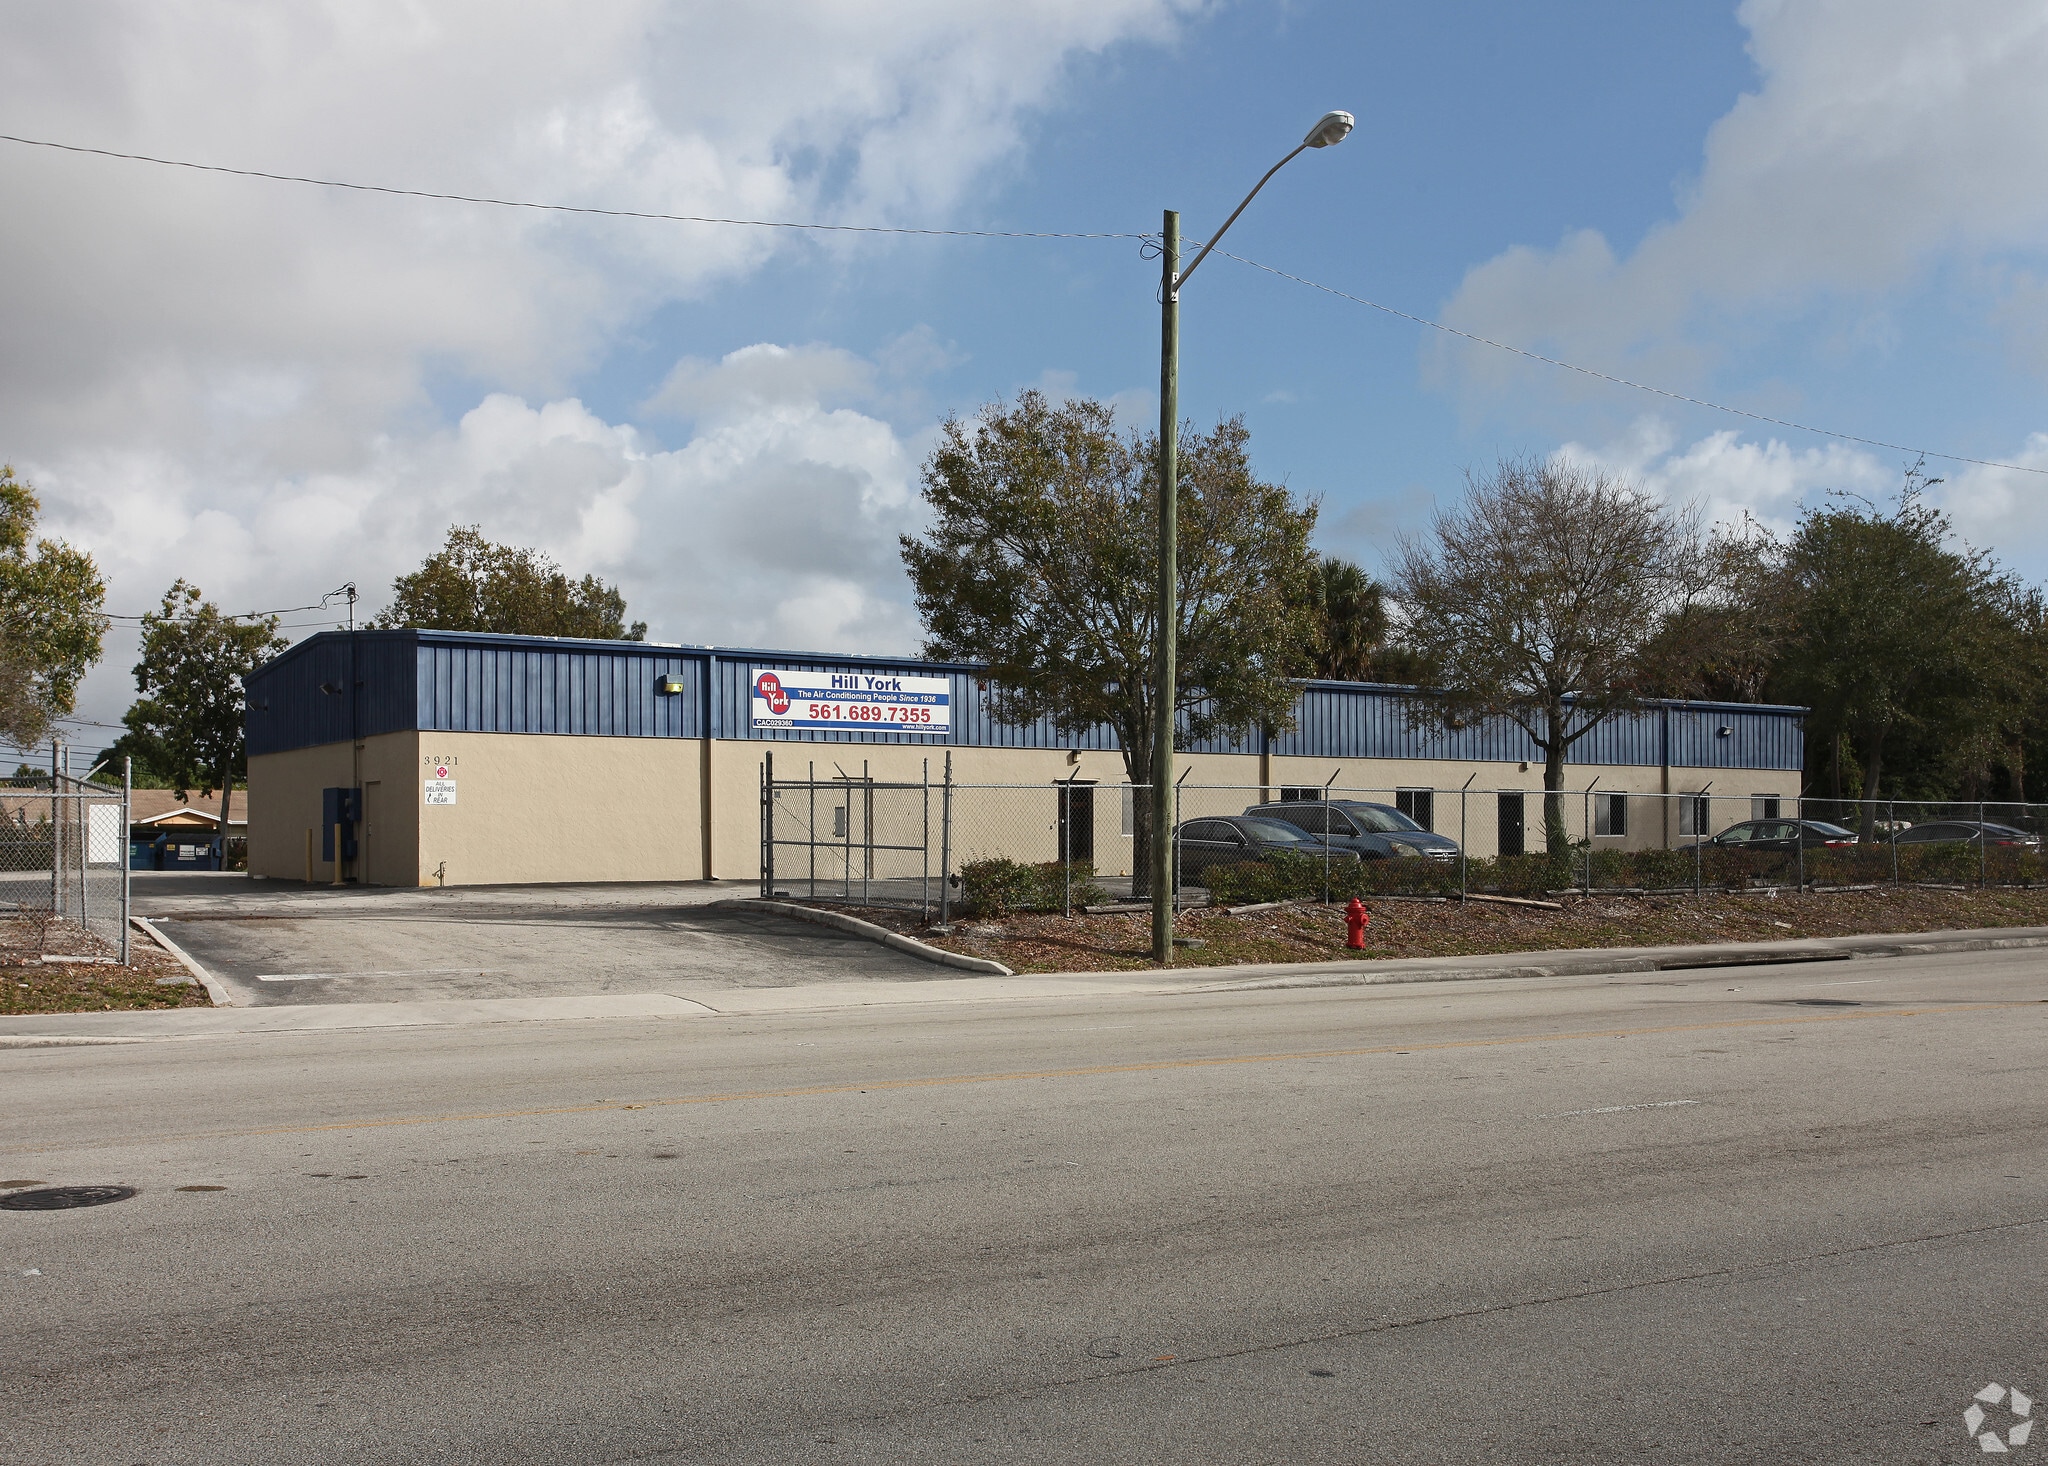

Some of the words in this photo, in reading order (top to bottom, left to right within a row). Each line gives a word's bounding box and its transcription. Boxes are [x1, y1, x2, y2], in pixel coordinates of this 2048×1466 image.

[761, 681, 777, 692] Hill
[831, 675, 858, 689] Hill
[864, 676, 902, 691] York
[768, 691, 789, 711] York
[798, 690, 811, 698] The
[825, 691, 872, 702] Conditioning
[873, 692, 897, 702] People
[899, 694, 919, 702] Since
[920, 695, 937, 703] 1936
[809, 703, 931, 723] 561.689.7355
[424, 755, 458, 766] 3921
